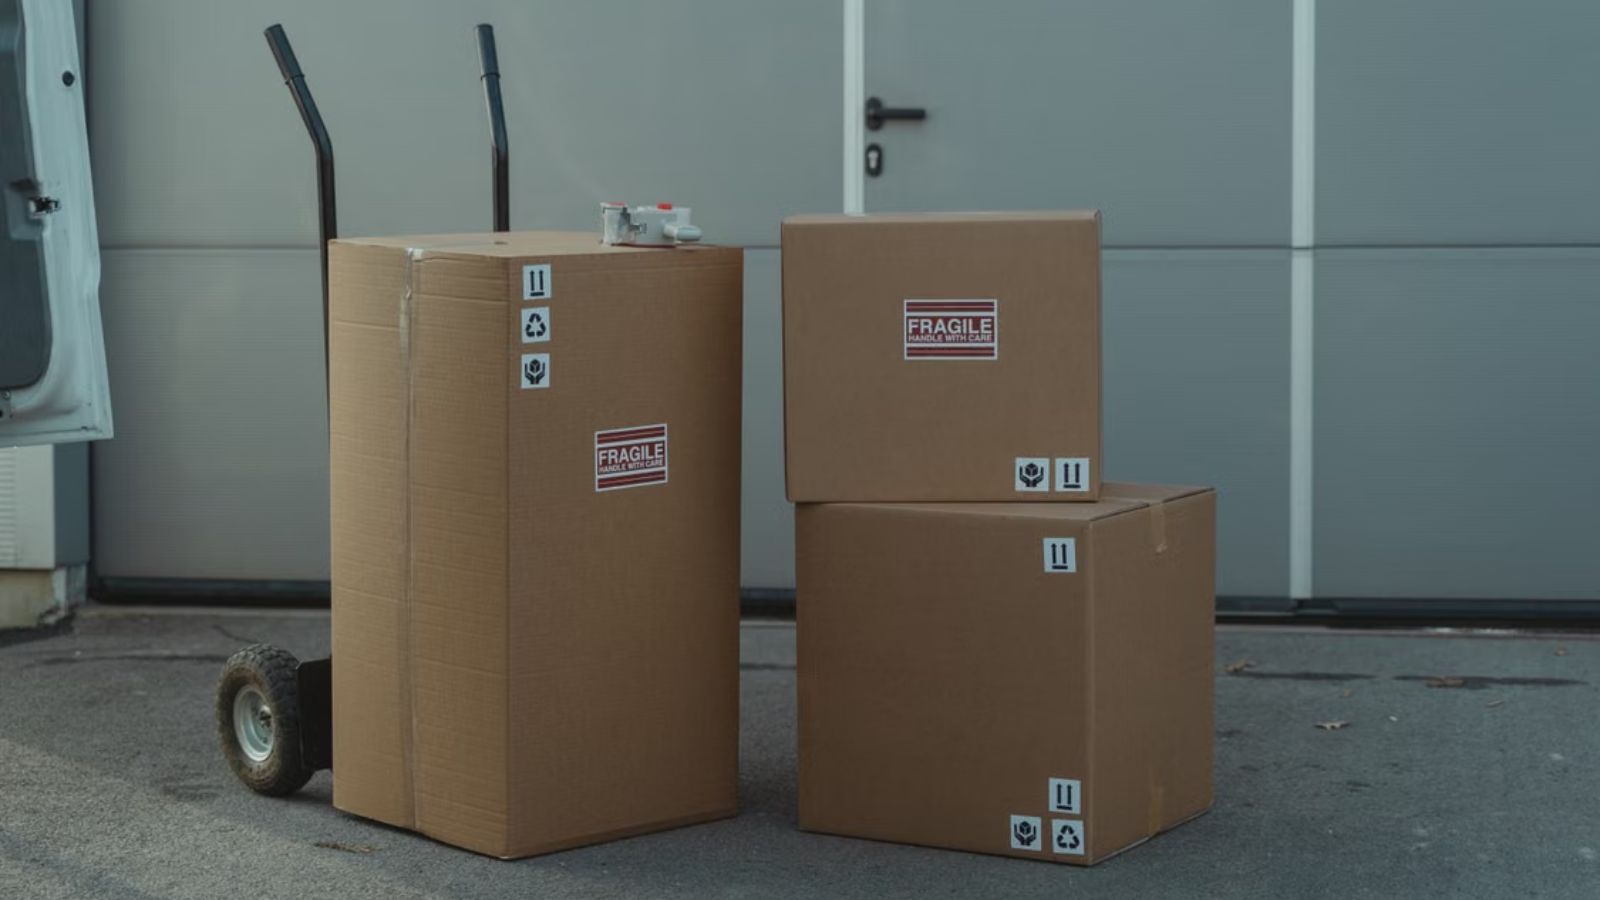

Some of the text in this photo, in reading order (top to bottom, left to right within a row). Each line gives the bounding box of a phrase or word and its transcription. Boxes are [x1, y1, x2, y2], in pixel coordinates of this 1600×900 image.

[908, 318, 992, 334] FRAGILE
[908, 334, 992, 342] HANDLE WITH CARE
[599, 443, 663, 465] FRAGILE
[599, 457, 663, 473] HANDLE WITH CARE
